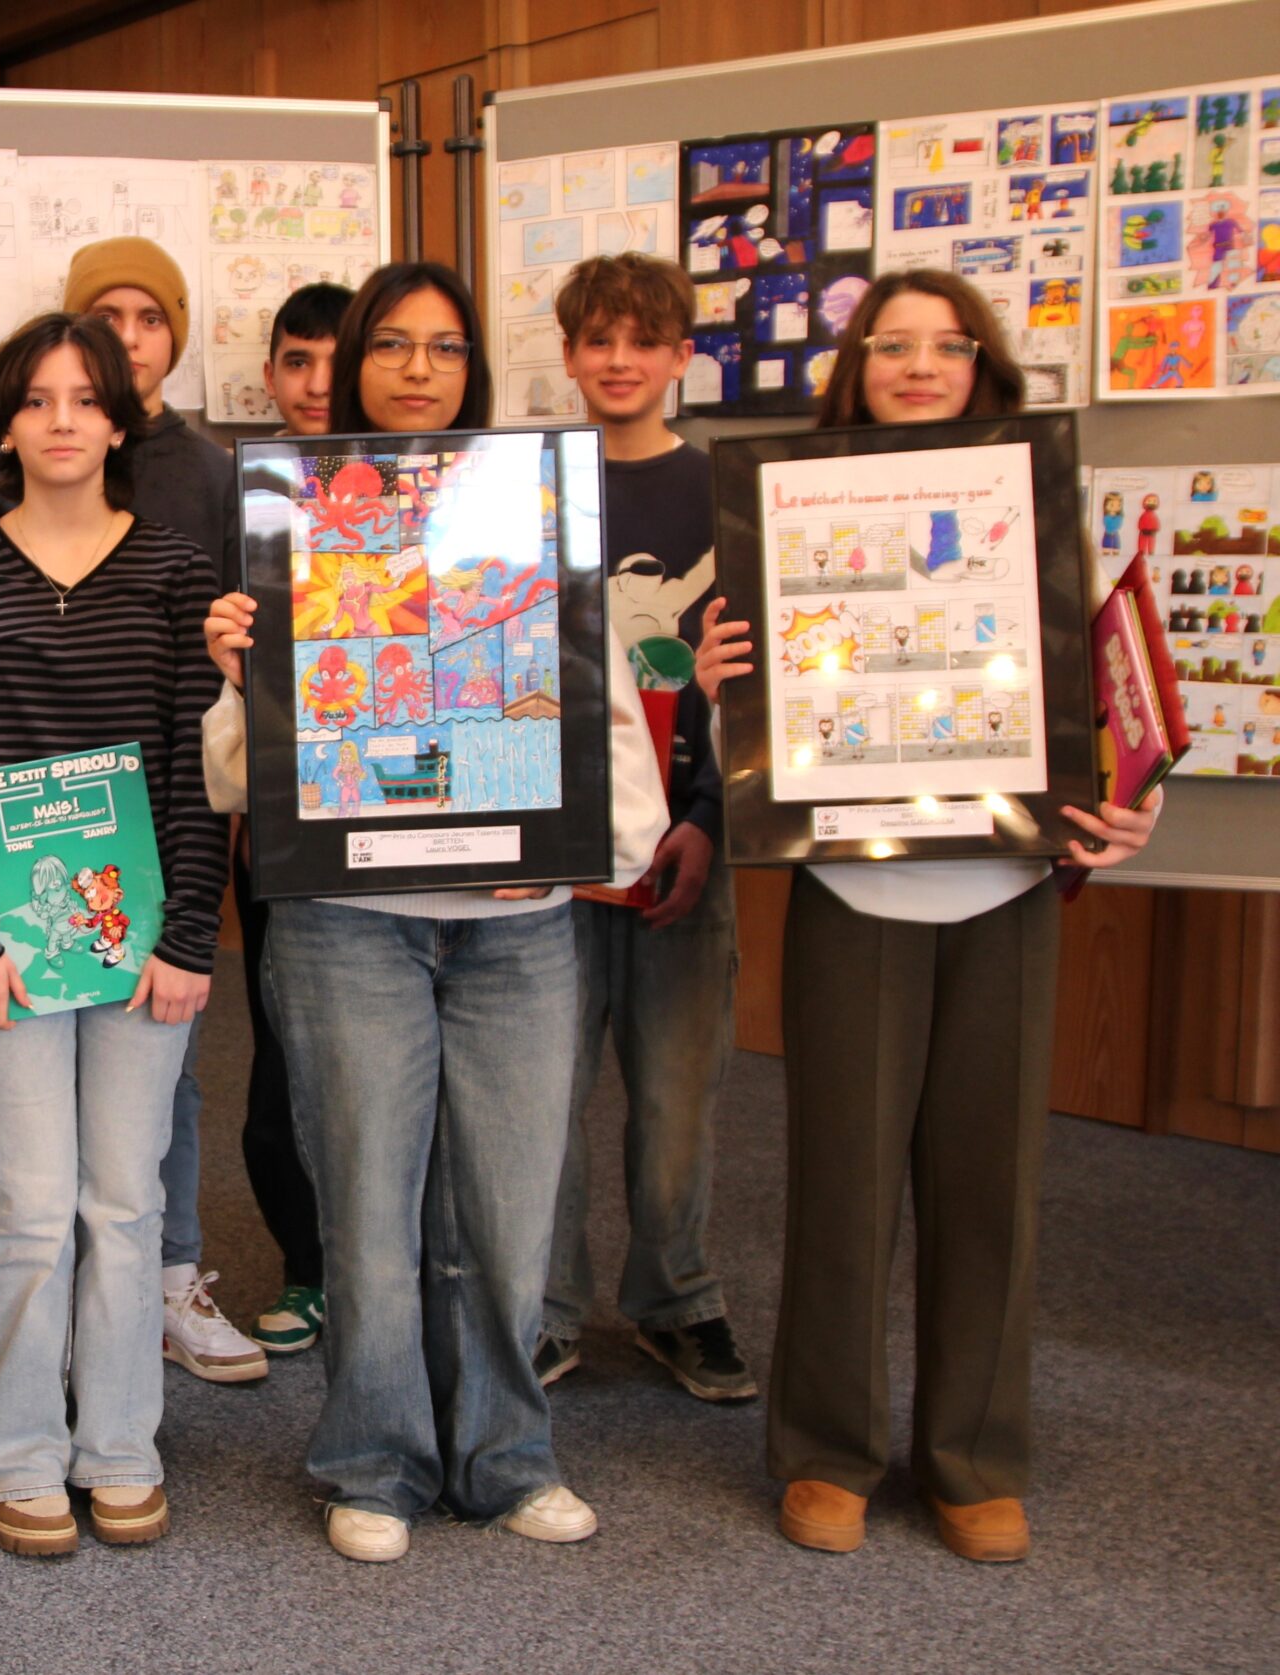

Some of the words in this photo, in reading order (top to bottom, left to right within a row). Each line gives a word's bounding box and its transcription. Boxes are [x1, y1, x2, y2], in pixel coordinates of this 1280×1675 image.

[774, 483, 798, 509] Le
[9, 766, 48, 785] PETIT
[51, 752, 117, 778] SPIROU
[83, 824, 118, 839] JANRY
[6, 840, 35, 853] TOME
